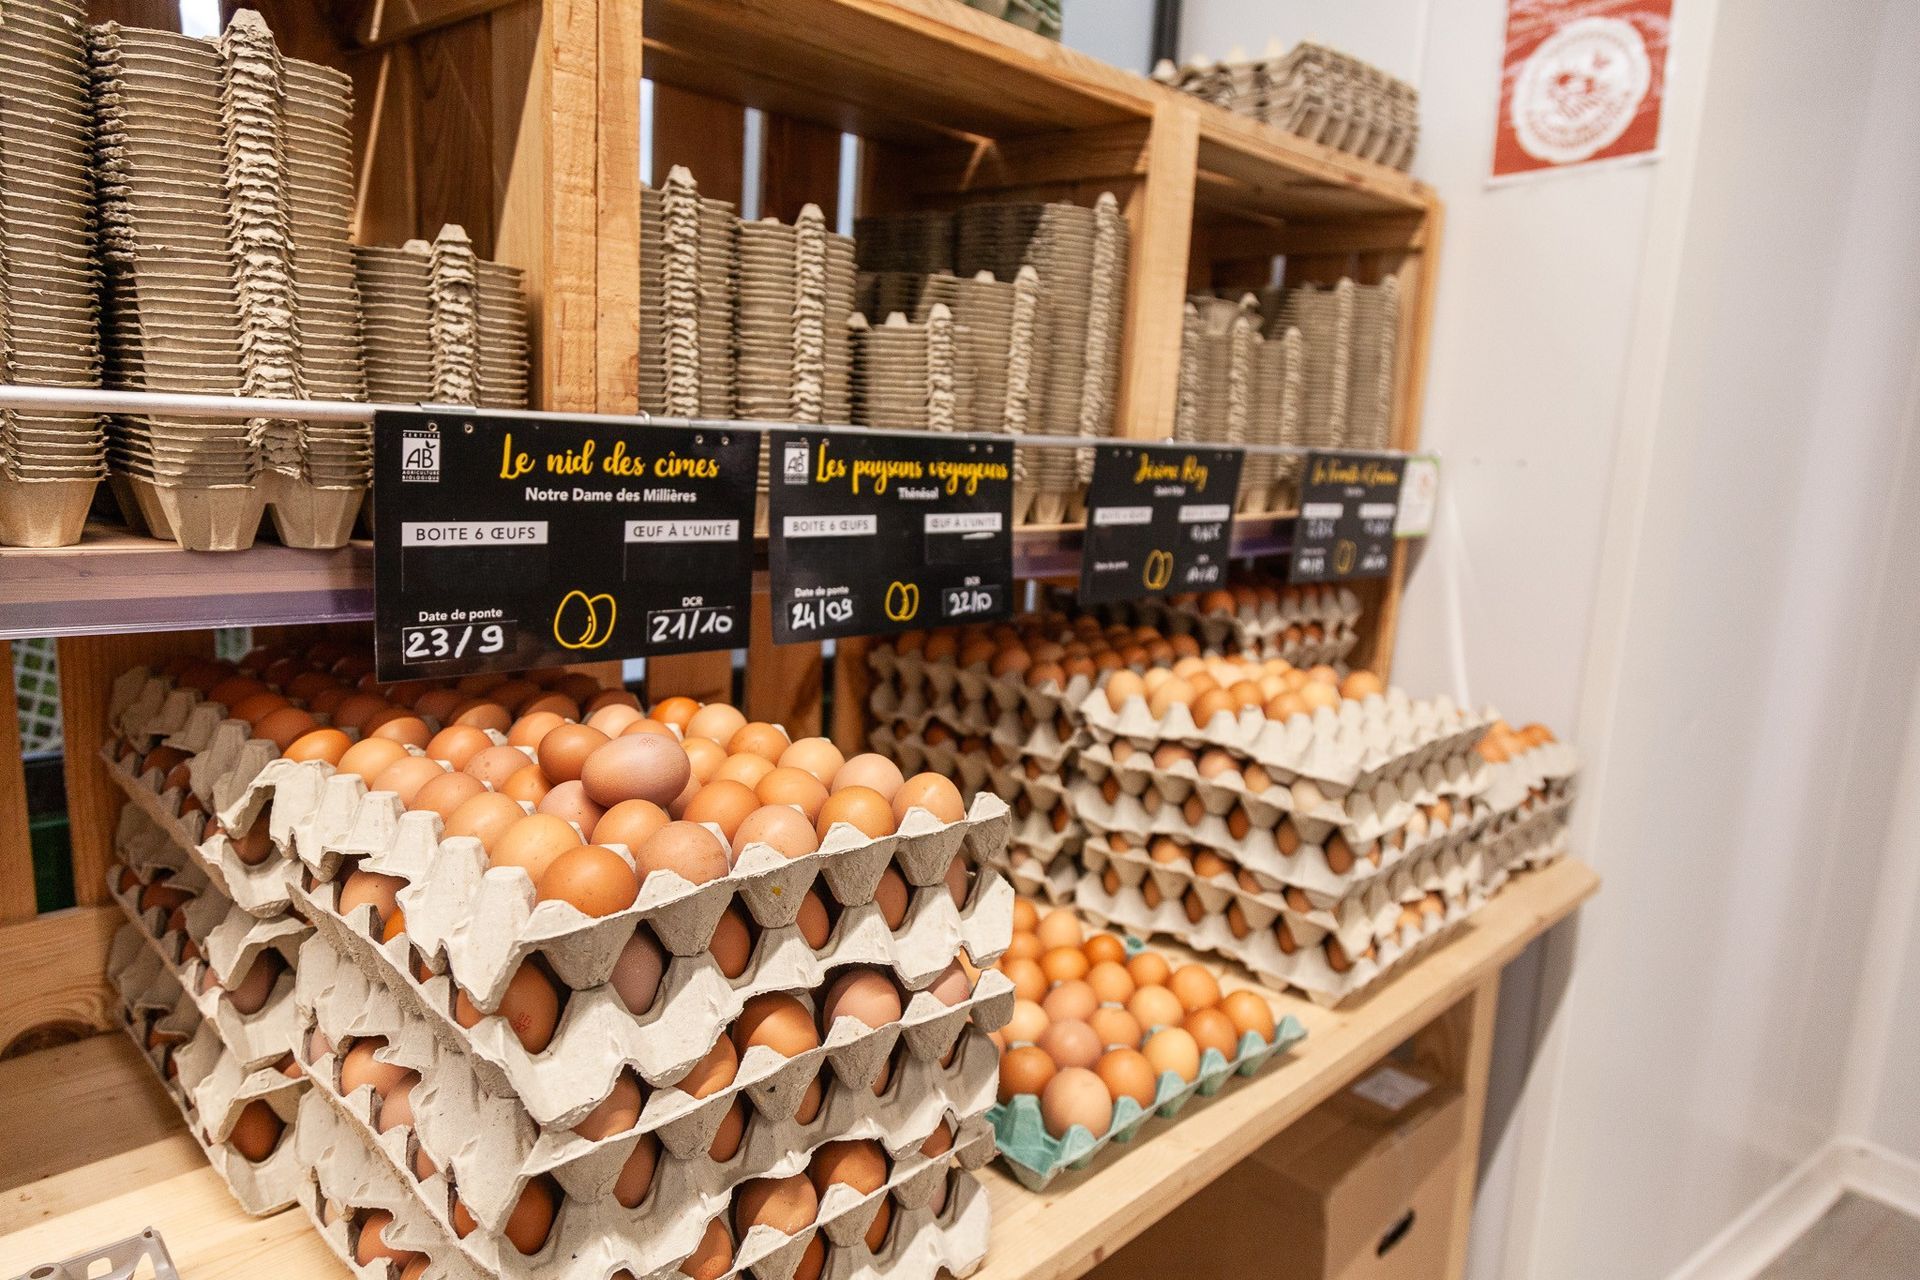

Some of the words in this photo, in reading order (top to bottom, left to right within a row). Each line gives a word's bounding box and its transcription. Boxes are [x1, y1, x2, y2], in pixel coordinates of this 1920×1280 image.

[405, 447, 434, 469] AB
[499, 433, 536, 480] Le
[547, 439, 596, 475] nid
[603, 439, 646, 476] des
[654, 451, 720, 478] cîmes
[816, 442, 847, 484] Les
[852, 460, 923, 495] paysans
[928, 460, 1009, 496] voyageurs
[525, 487, 569, 502] Notre
[573, 488, 613, 502] Dame
[616, 488, 641, 502] des
[643, 488, 697, 503] Millières
[416, 527, 468, 541] BOITE
[475, 527, 484, 540] 6
[491, 526, 536, 540] ŒUFS
[633, 525, 664, 538] ŒUF
[668, 523, 679, 537] À
[792, 519, 826, 533] BOITE
[682, 597, 703, 608] DCR
[418, 610, 447, 623] Date
[450, 609, 467, 621] de
[469, 608, 503, 624] ponte
[791, 598, 853, 631] 24/09
[651, 610, 733, 642] 21/10
